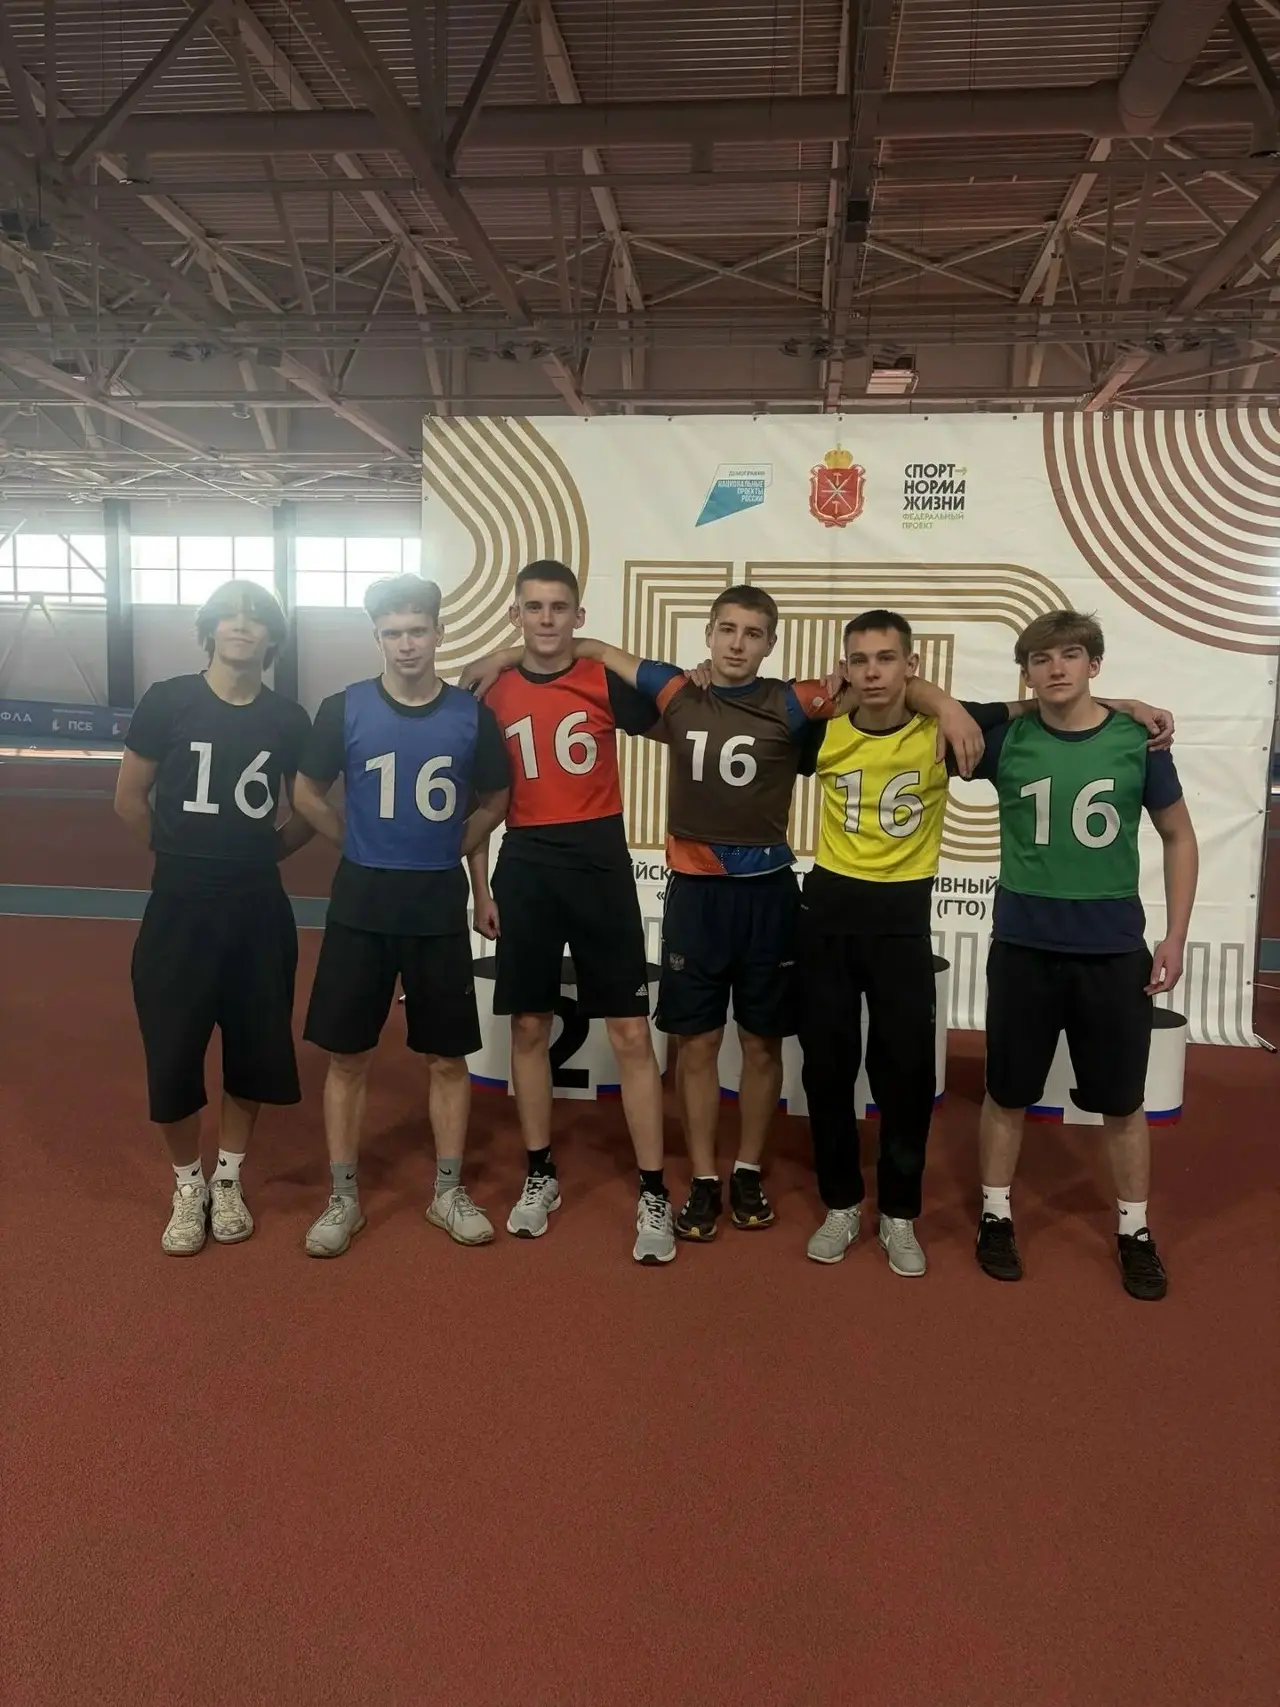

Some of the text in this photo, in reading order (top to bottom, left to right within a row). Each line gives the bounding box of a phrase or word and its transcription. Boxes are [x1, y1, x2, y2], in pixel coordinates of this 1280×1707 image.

[904, 463, 956, 478] СПОРТ
[718, 480, 764, 488] НАЦИОНАЛЬНЫЕ
[737, 487, 764, 495] ПРОЕКТЫ
[904, 480, 966, 494] НОРМА
[903, 496, 965, 510] ЖИЗНИ
[902, 511, 965, 520] ФЕДЕРАЛЬНЫЙ
[68, 720, 93, 731] ПСБ
[504, 710, 598, 780] 16
[685, 730, 758, 787] 16
[183, 741, 275, 819] 16
[365, 751, 457, 822] 16
[835, 769, 925, 838] 16
[1020, 776, 1121, 849] 16
[937, 899, 987, 920] (ГТО)
